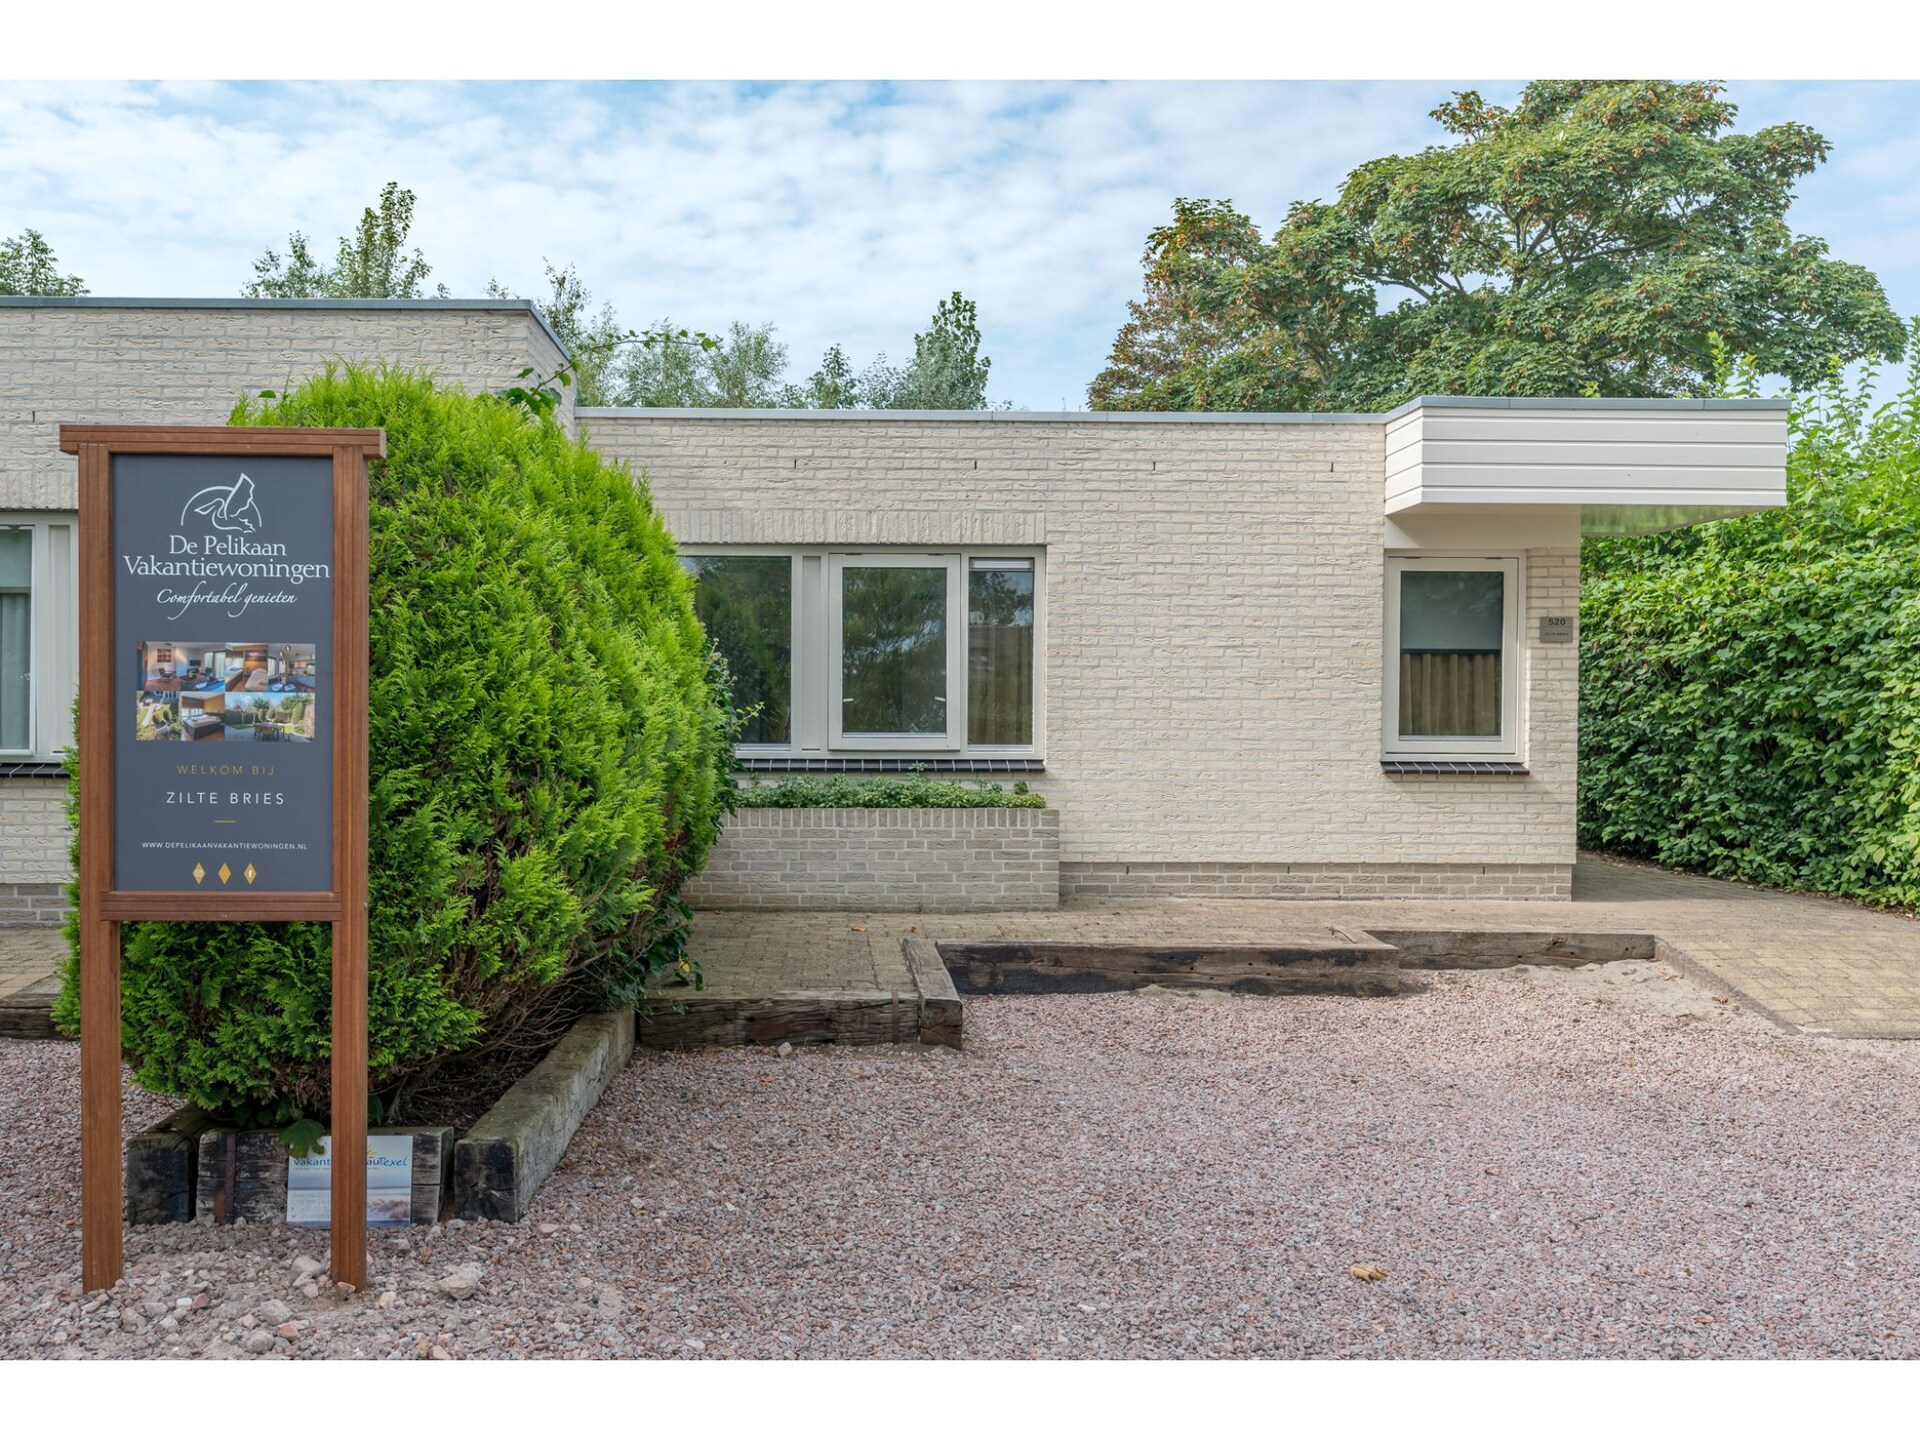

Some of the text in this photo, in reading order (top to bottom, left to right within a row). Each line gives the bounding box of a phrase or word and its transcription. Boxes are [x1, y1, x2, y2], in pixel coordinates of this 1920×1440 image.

[169, 534, 287, 556] De Pelikaan
[123, 555, 331, 585] Vakantiewoningen
[156, 580, 298, 621] Comfortabel genieten
[1548, 617, 1566, 626] 520
[176, 765, 275, 777] WELKOM BIJ
[166, 791, 285, 805] ZILTE BRIES
[141, 841, 308, 850] WWW.DEPELIKAANVAKANTIEWONINGEN.NL
